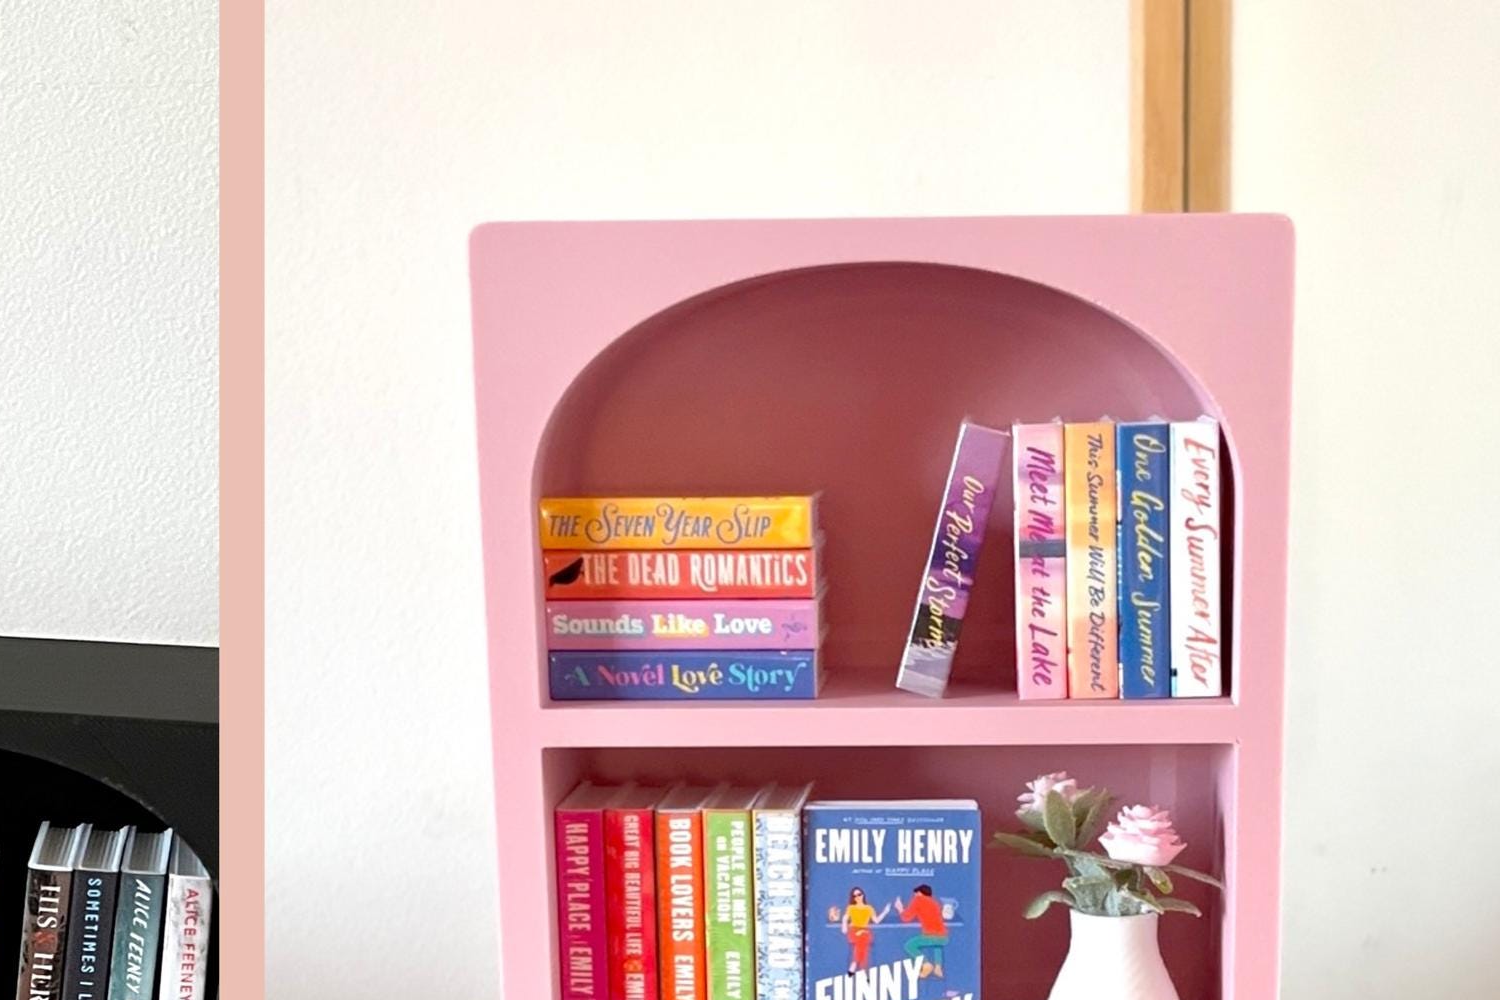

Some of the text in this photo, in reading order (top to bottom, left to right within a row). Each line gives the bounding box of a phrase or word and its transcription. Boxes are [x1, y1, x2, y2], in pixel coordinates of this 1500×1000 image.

[1132, 433, 1165, 482] One
[549, 503, 771, 544] THE SEVEN YEAR SLIP
[1132, 490, 1164, 583] Golden
[582, 553, 622, 586] THE
[628, 553, 680, 586] DEAD
[926, 475, 985, 649] Our Perfect Storm
[1026, 446, 1058, 687] Meet Me at the Lake
[1181, 438, 1219, 687] Every Summer After
[553, 614, 772, 635] Sounds Like Love
[564, 663, 806, 693] A Novel Love Story
[668, 818, 692, 869] BOOK
[815, 829, 972, 864] EMILY HENRY
[81, 878, 101, 974] SOMETIMES
[184, 888, 199, 936] ALICE
[671, 873, 696, 942] LOVERS
[125, 878, 152, 994] ALICE FEENEY
